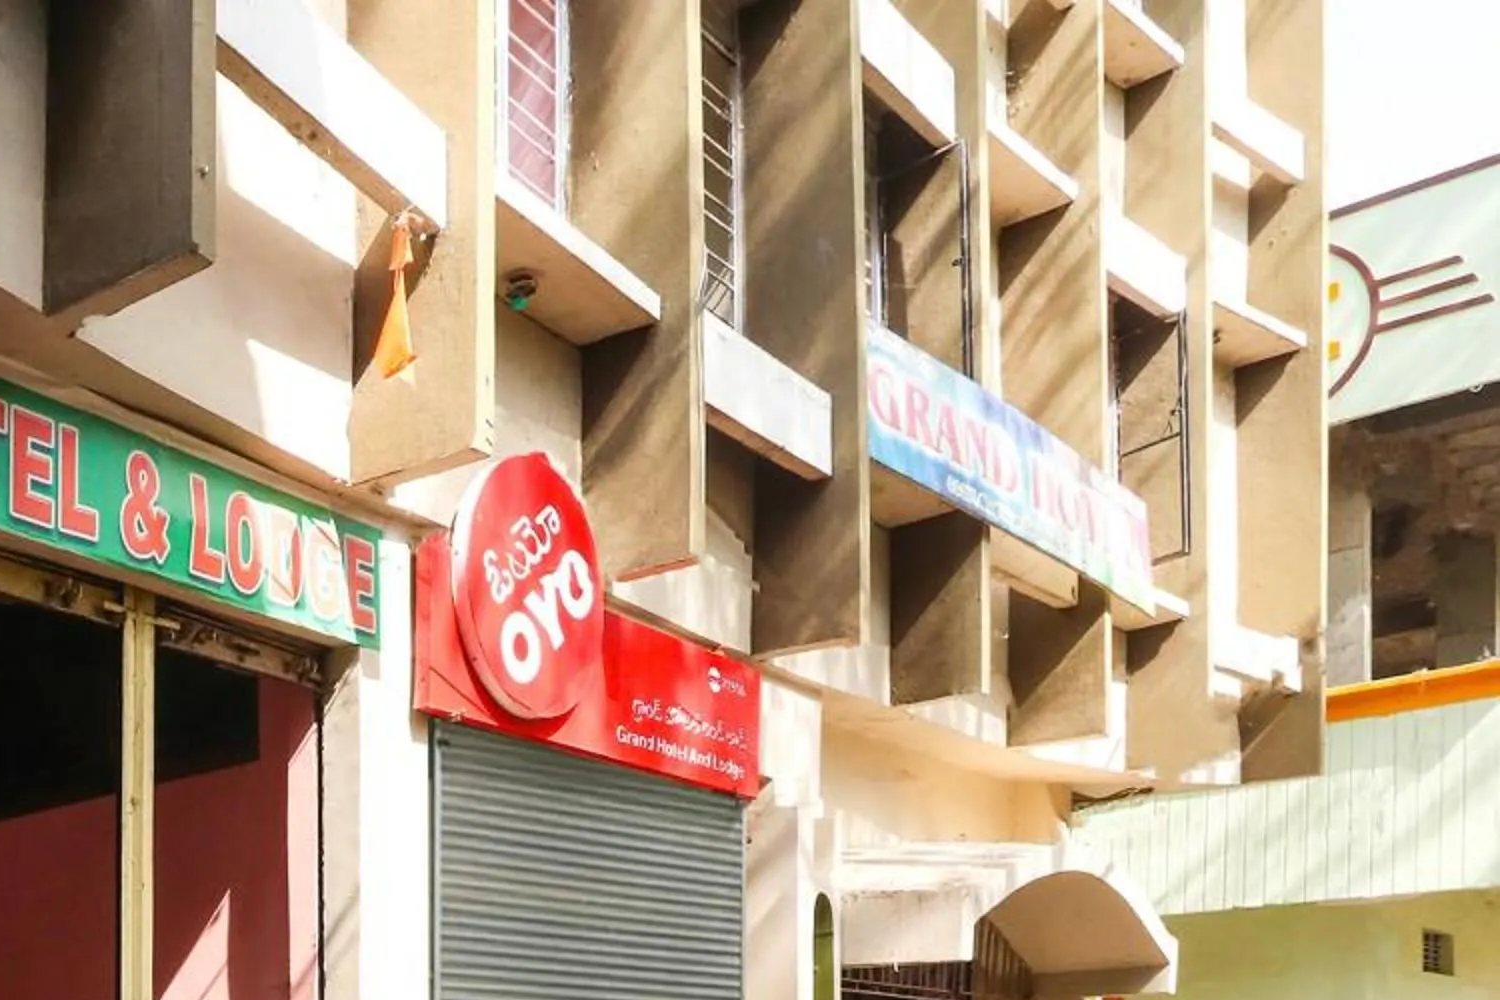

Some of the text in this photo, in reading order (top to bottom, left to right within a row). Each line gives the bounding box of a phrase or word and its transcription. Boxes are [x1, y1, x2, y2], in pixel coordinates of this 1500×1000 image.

[867, 362, 1020, 494] GRAND
[120, 450, 170, 564] &
[189, 472, 377, 635] LODGE
[500, 550, 594, 684] OYO
[616, 724, 655, 751] Grand
[656, 736, 688, 761] Hotel
[689, 747, 711, 768] And
[713, 755, 746, 782] Lodge
